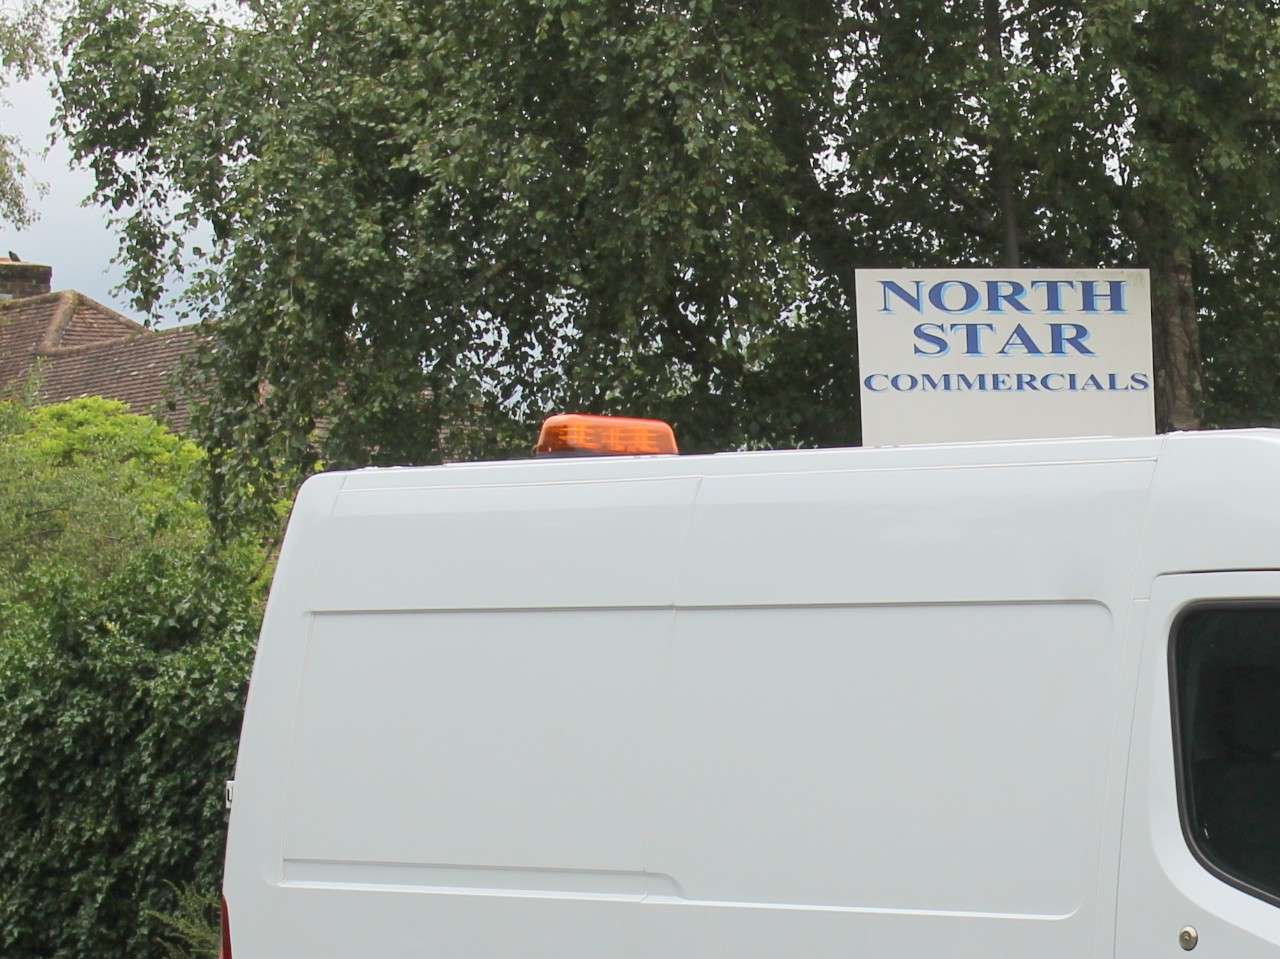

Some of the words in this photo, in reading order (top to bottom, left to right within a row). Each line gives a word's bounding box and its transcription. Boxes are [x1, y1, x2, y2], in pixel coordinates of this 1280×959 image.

[877, 280, 1128, 314] NORTH
[913, 322, 1096, 357] STAR
[863, 373, 1150, 392] COMMERCIALS
